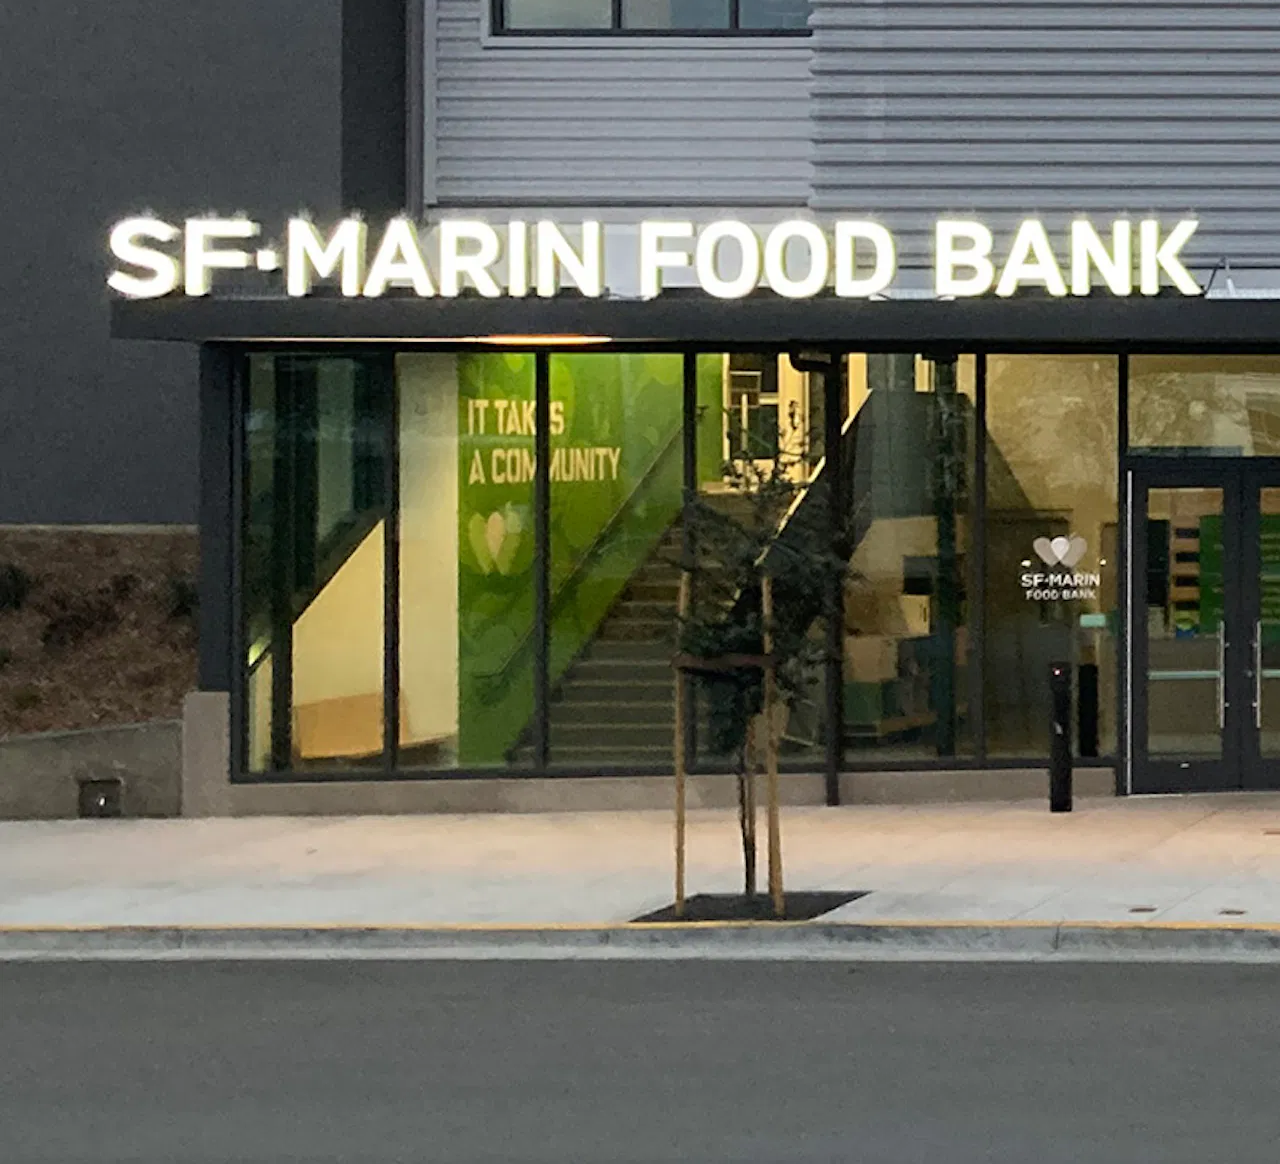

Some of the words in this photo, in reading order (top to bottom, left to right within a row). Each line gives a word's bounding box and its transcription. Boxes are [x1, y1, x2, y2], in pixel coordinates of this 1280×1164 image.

[638, 219, 897, 298] FOOD
[934, 219, 1203, 297] BANK
[468, 399, 489, 436] IT
[494, 399, 565, 436] TAKS
[468, 449, 486, 484] A
[491, 447, 621, 484] COMMUNITY
[1025, 589, 1059, 600] FOOD
[1062, 589, 1097, 600] BANK
